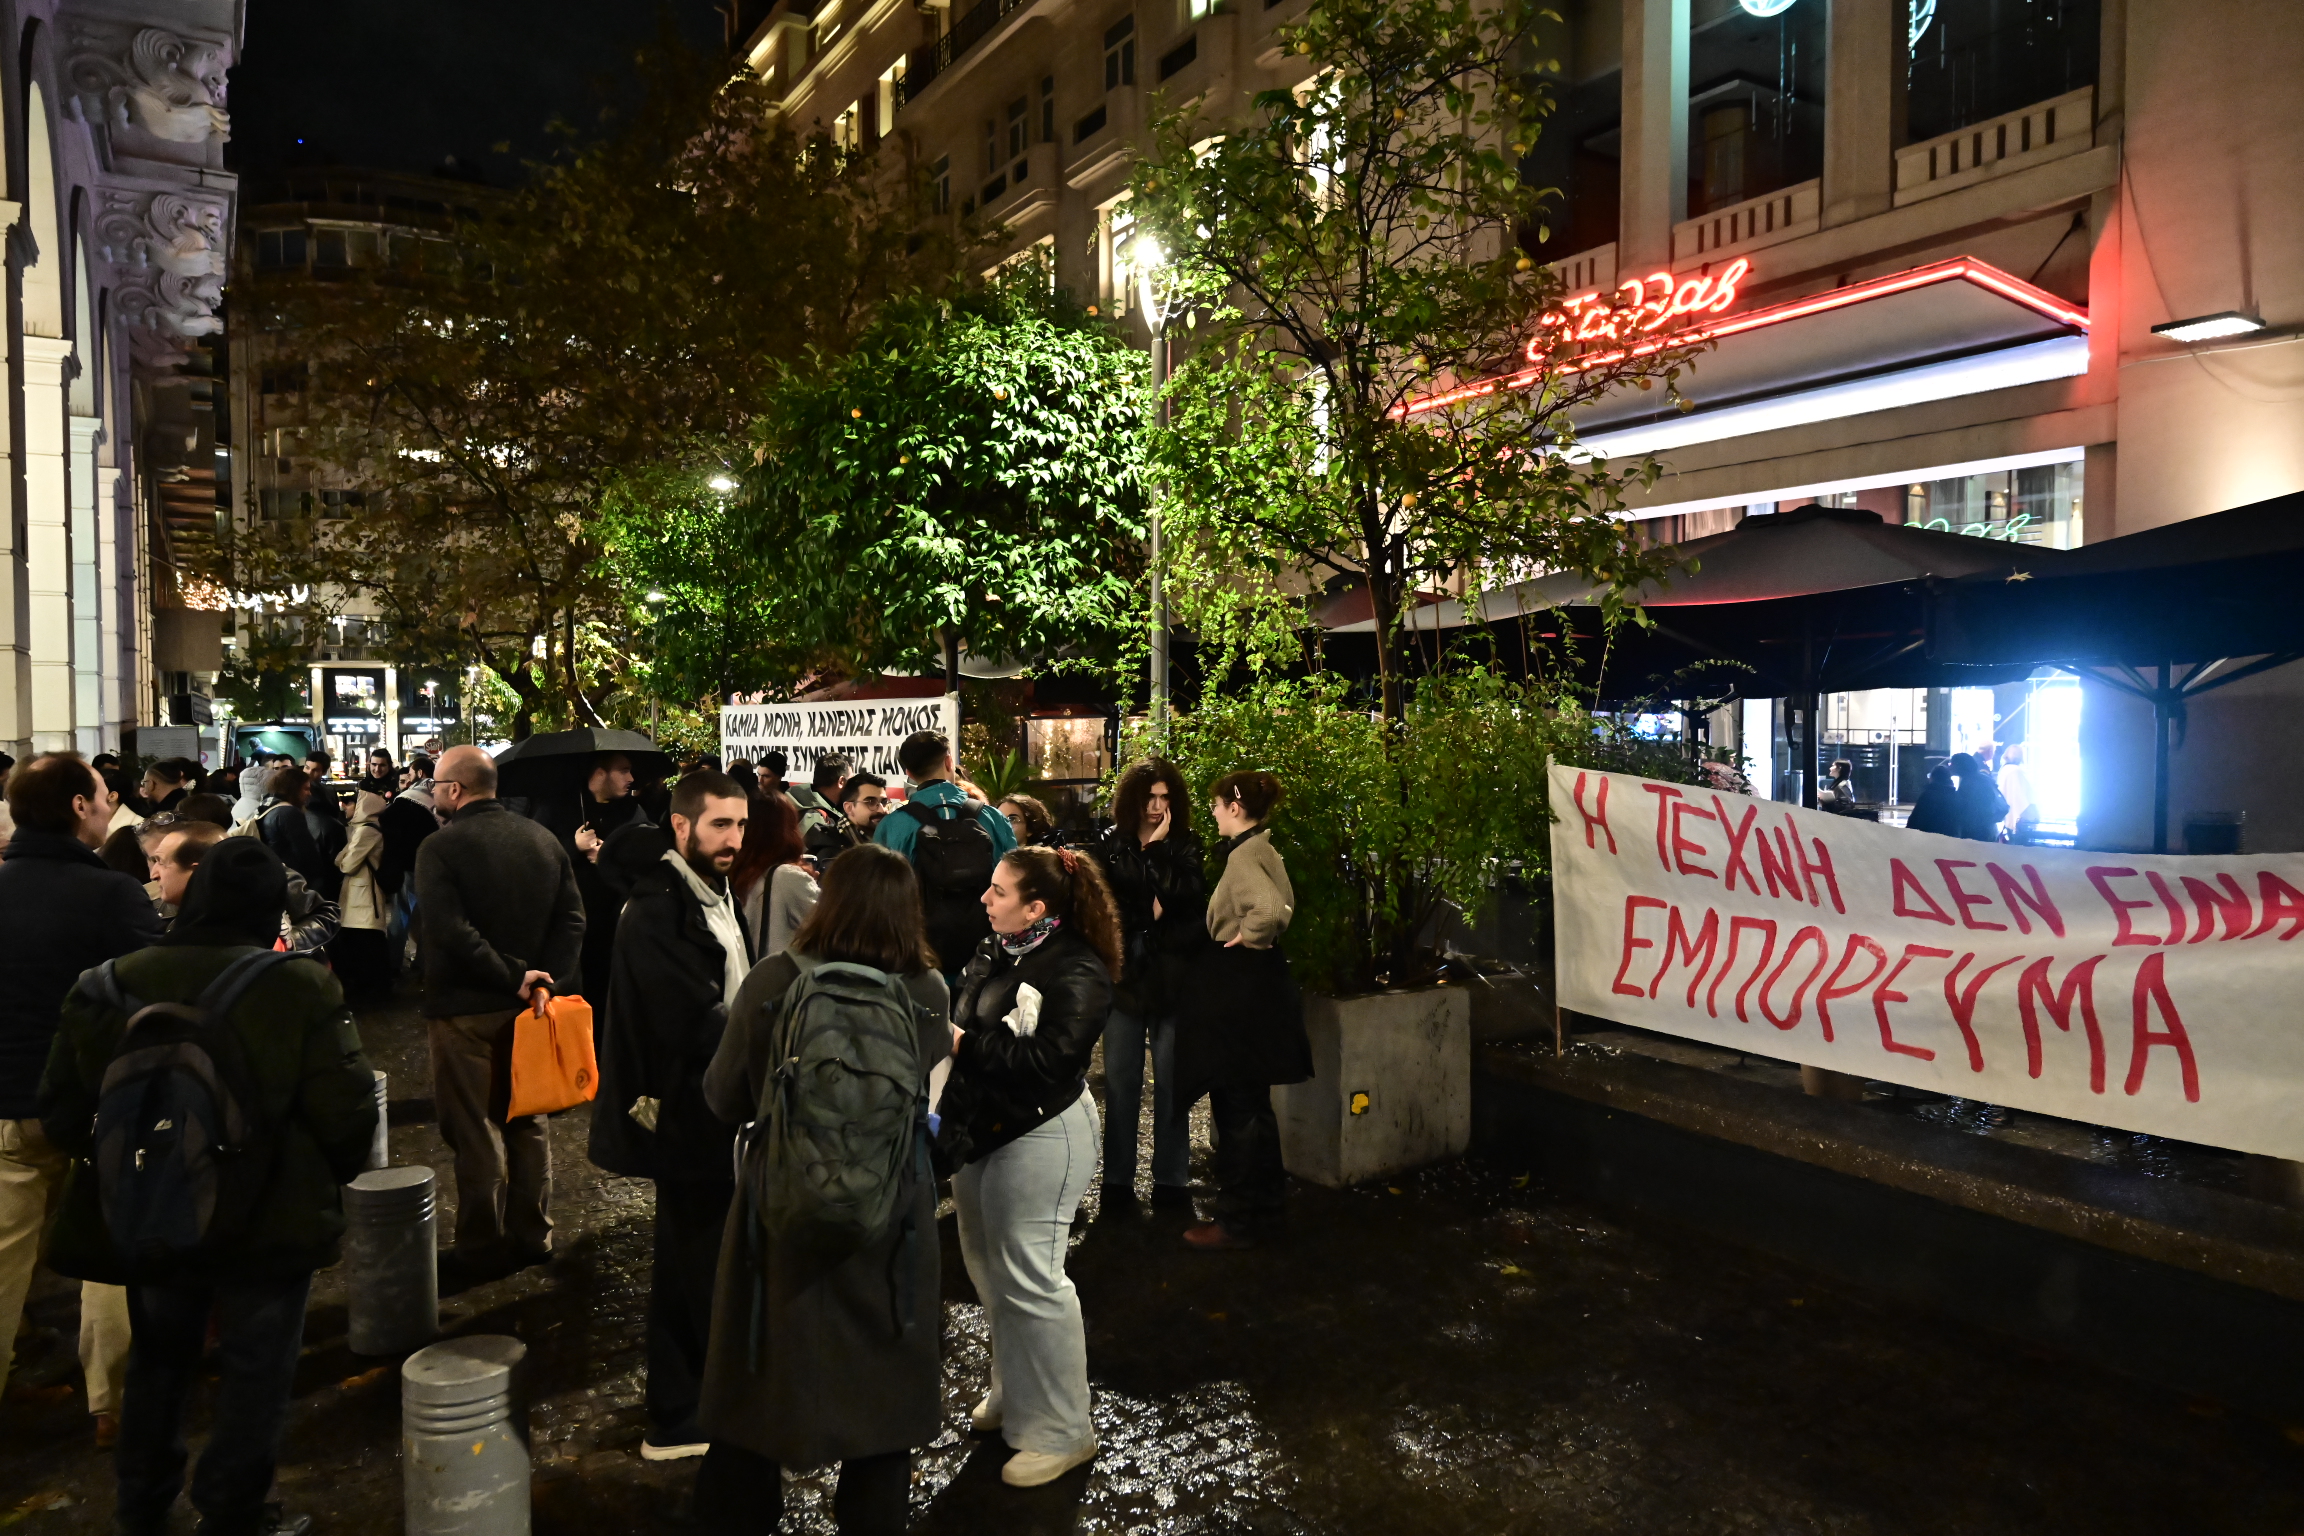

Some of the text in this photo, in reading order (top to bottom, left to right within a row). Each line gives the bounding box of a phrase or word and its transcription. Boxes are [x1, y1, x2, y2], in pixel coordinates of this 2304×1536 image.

[725, 713, 759, 737] ΚΑΜΙΑ
[762, 712, 803, 742] ΜΟΝΗ,
[1574, 772, 1617, 855] Η
[1642, 784, 1846, 914] ΤΕΧΝΗ
[1891, 858, 2066, 938] ΔΕΝ
[1612, 895, 2200, 1103] ΕΜΠΟΡΕΥΜΑ
